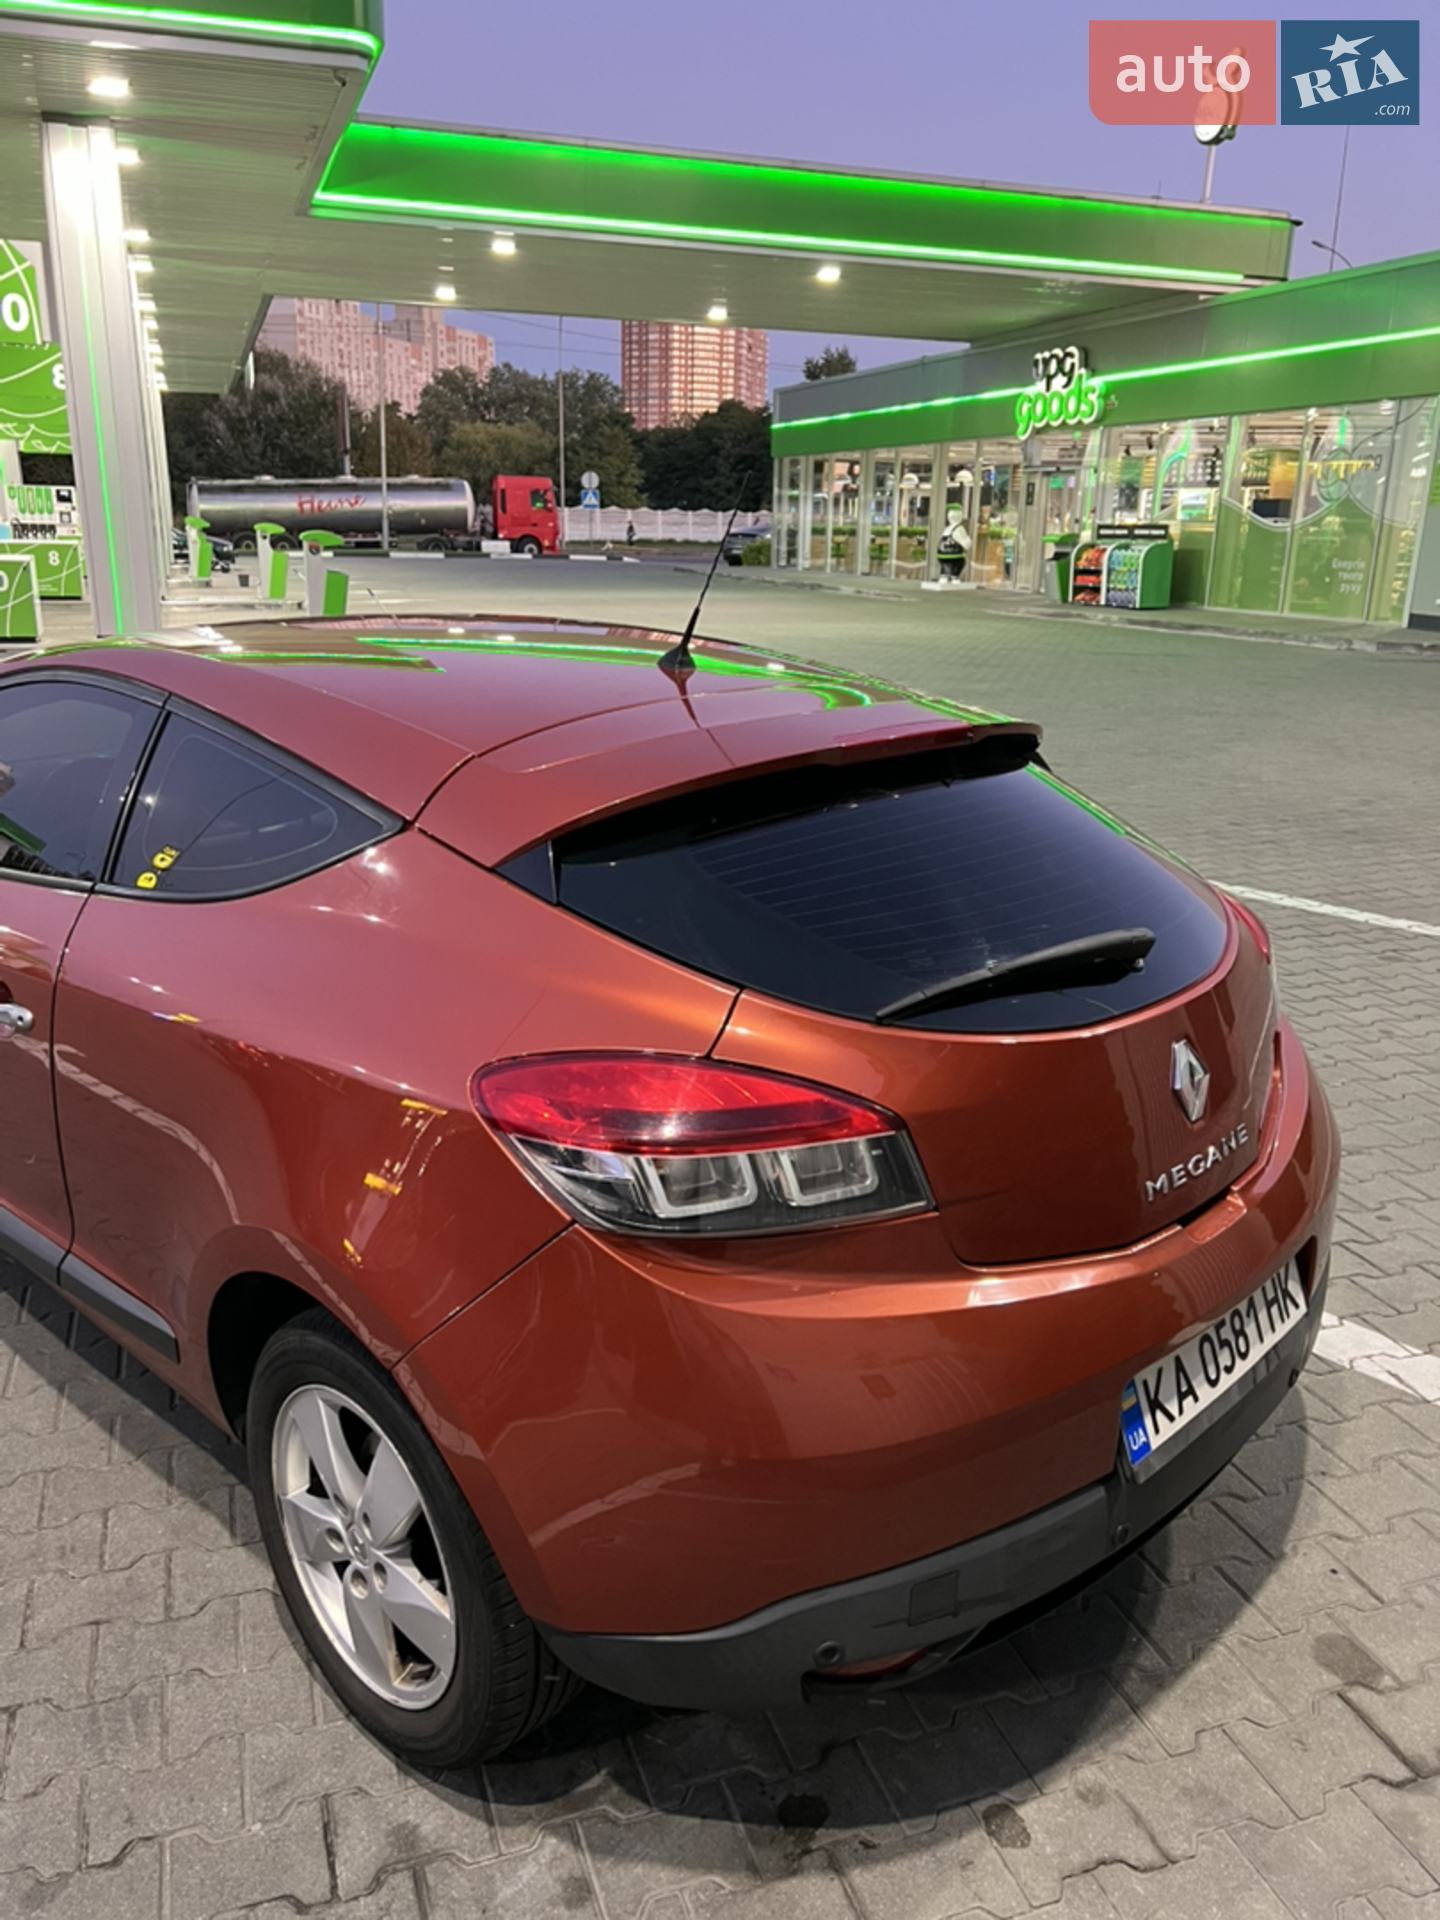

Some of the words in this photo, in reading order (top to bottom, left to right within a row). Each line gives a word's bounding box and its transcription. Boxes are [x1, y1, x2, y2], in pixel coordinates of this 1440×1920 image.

[1033, 347, 1079, 393] upg
[1015, 368, 1097, 440] goods
[49, 550, 60, 566] 8
[1145, 1123, 1249, 1202] MEGANE
[1142, 1353, 1199, 1435] KA
[1198, 1296, 1265, 1389] 0581
[1261, 1262, 1300, 1335] HK
[1128, 1427, 1148, 1451] UA
